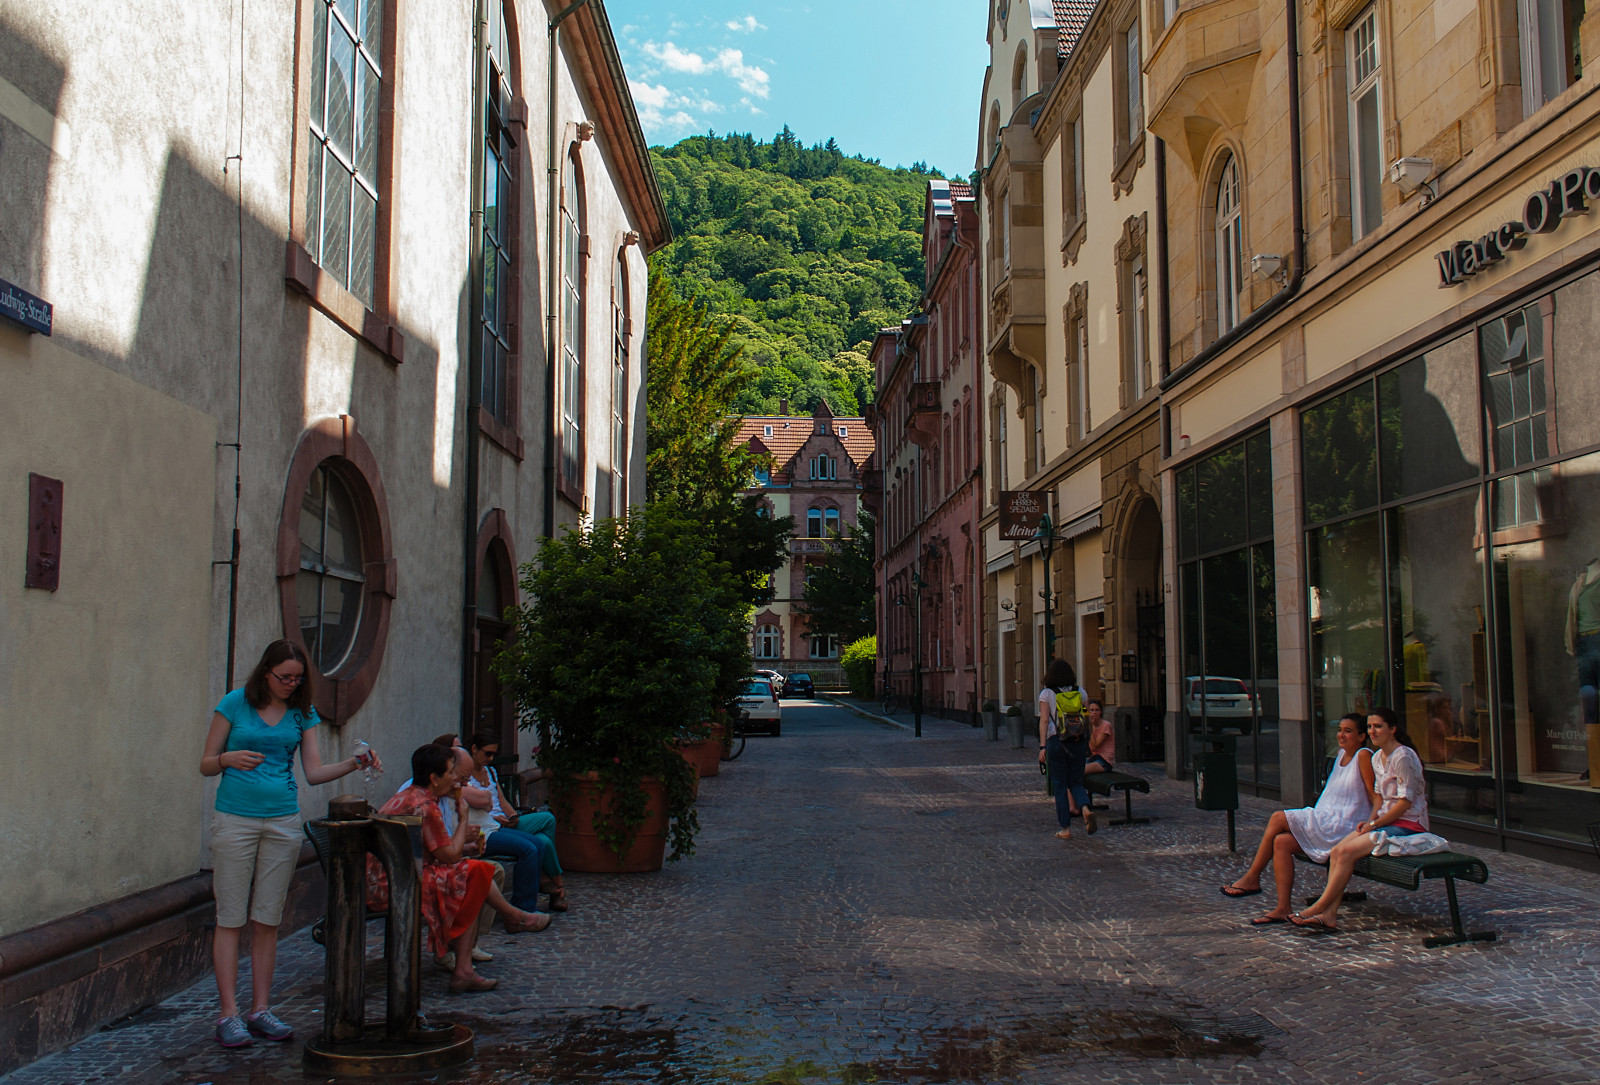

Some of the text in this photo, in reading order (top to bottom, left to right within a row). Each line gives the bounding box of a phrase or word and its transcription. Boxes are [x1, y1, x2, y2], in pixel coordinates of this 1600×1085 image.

[1434, 222, 1520, 290] Marc
[0, 287, 51, 327] udwig-Straße
[1009, 505, 1040, 513] SPEZIALIST
[1546, 728, 1566, 739] Marc
